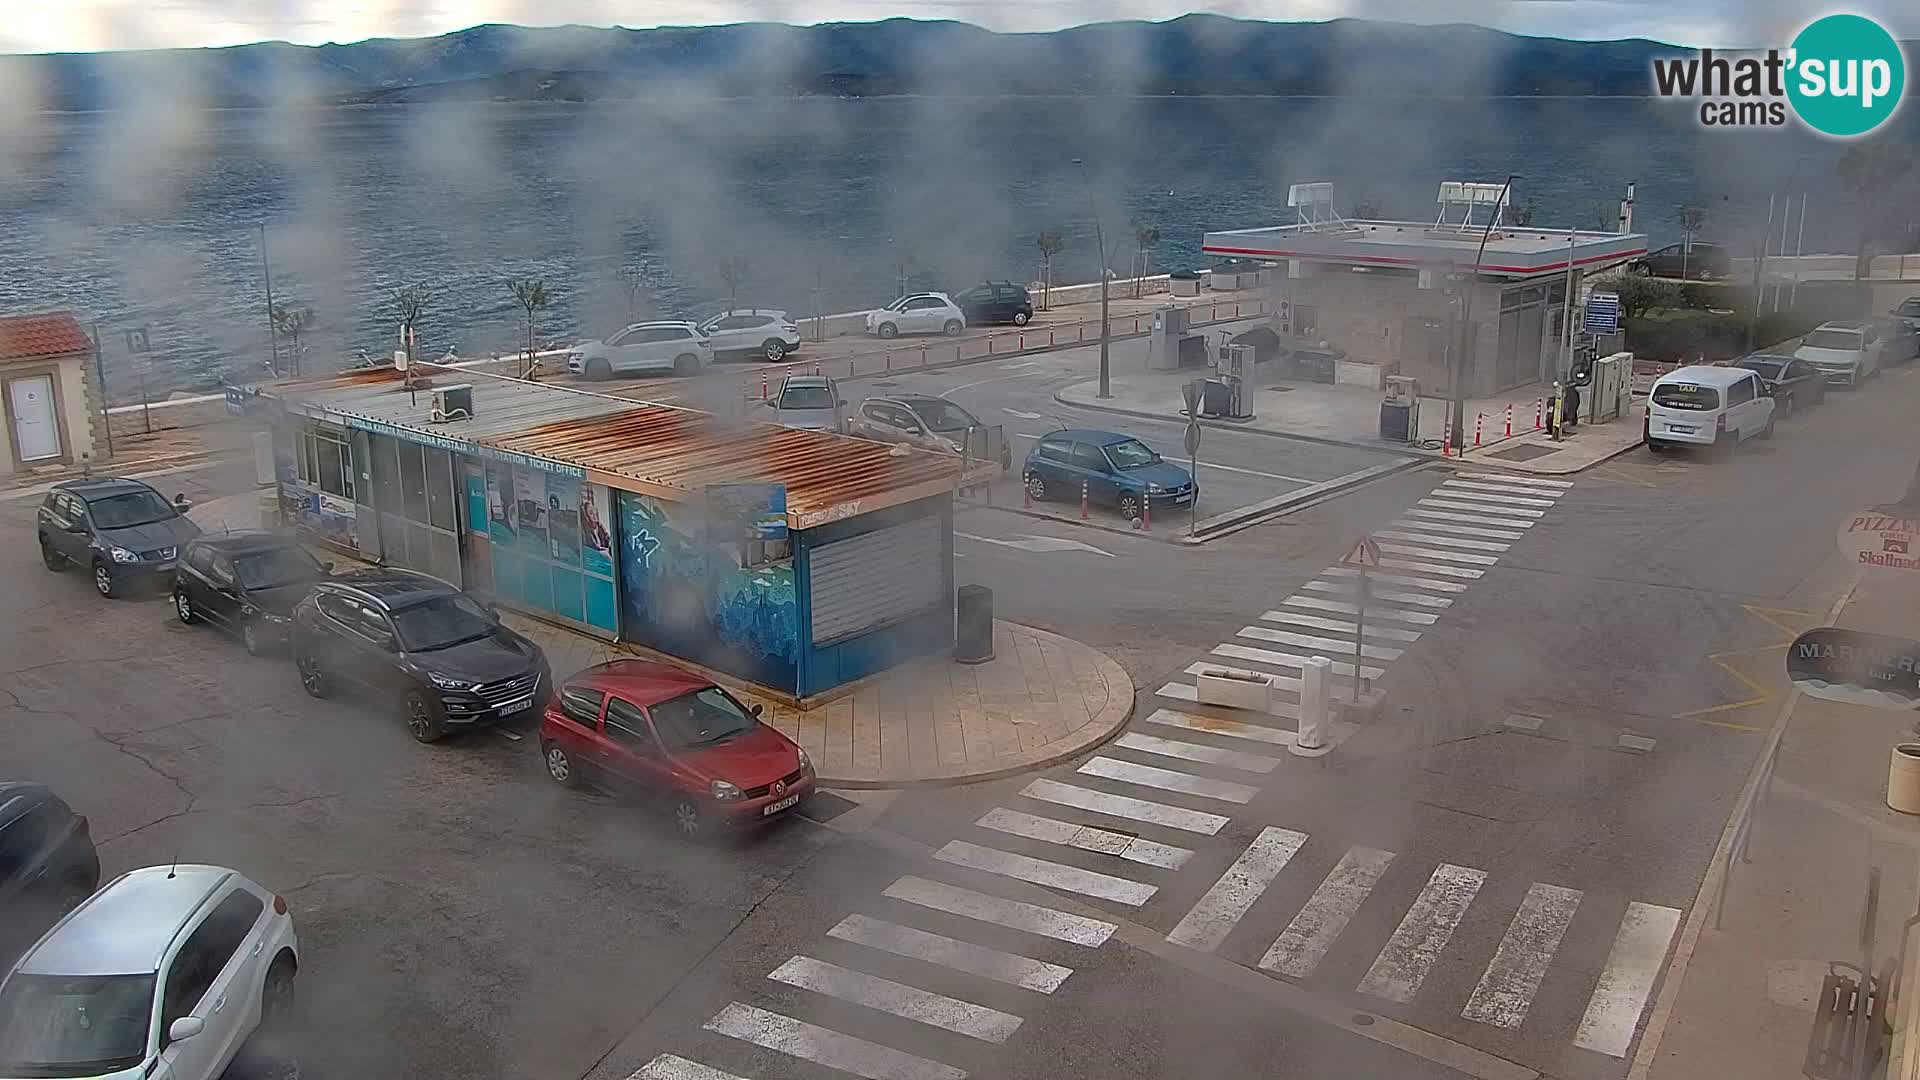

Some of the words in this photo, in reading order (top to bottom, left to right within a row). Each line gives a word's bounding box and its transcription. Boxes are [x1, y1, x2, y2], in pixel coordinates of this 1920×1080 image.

[1679, 385, 1697, 393] TAXI
[437, 438, 467, 451] POSTAJA
[495, 450, 526, 465] STATION
[528, 457, 554, 472] TICKET
[556, 463, 582, 478] OFFICE
